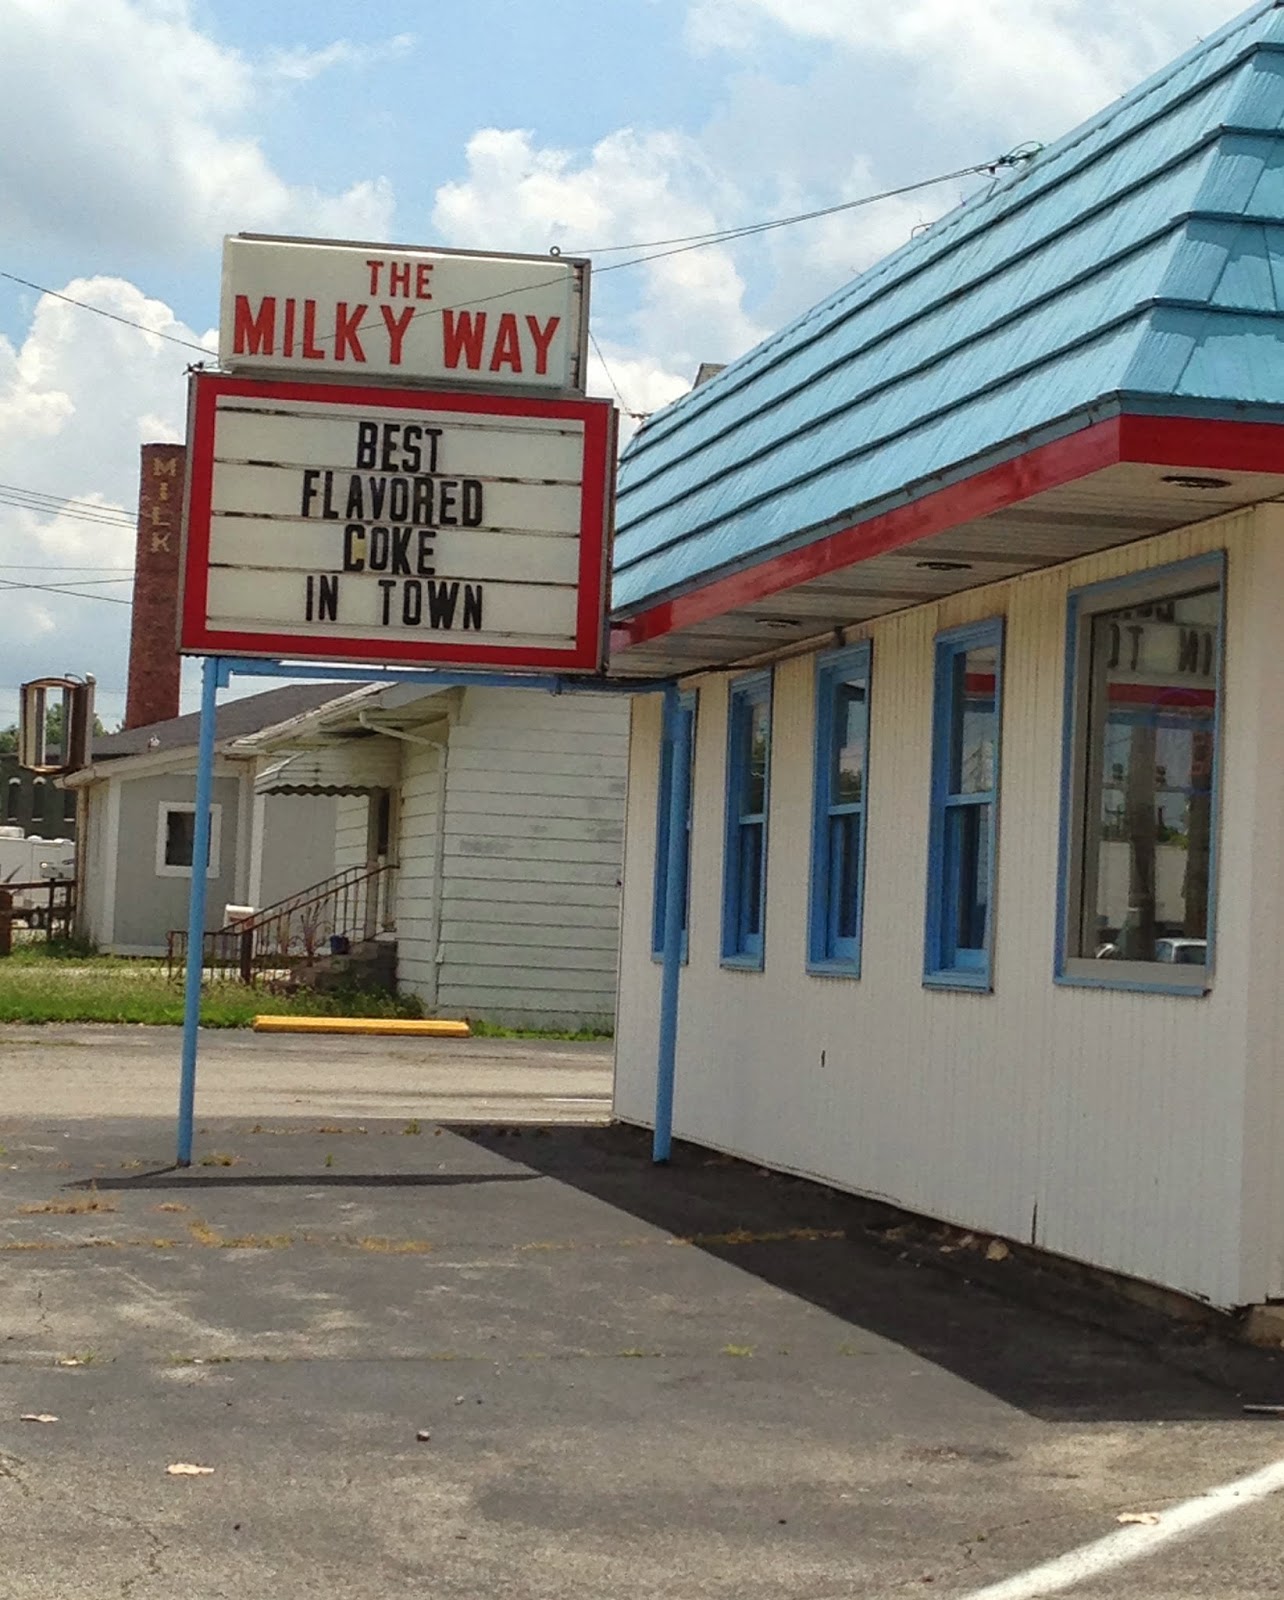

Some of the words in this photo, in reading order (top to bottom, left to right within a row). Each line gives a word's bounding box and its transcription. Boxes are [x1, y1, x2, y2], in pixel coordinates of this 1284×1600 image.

[368, 261, 434, 299] THE
[233, 295, 415, 365] MILKY
[443, 309, 560, 375] WAY
[357, 422, 443, 472] BEST
[150, 458, 177, 553] MILK
[302, 470, 483, 527] FLAVORED
[344, 524, 436, 575] COKE
[306, 575, 339, 621] IN
[379, 579, 483, 630] TOWN
